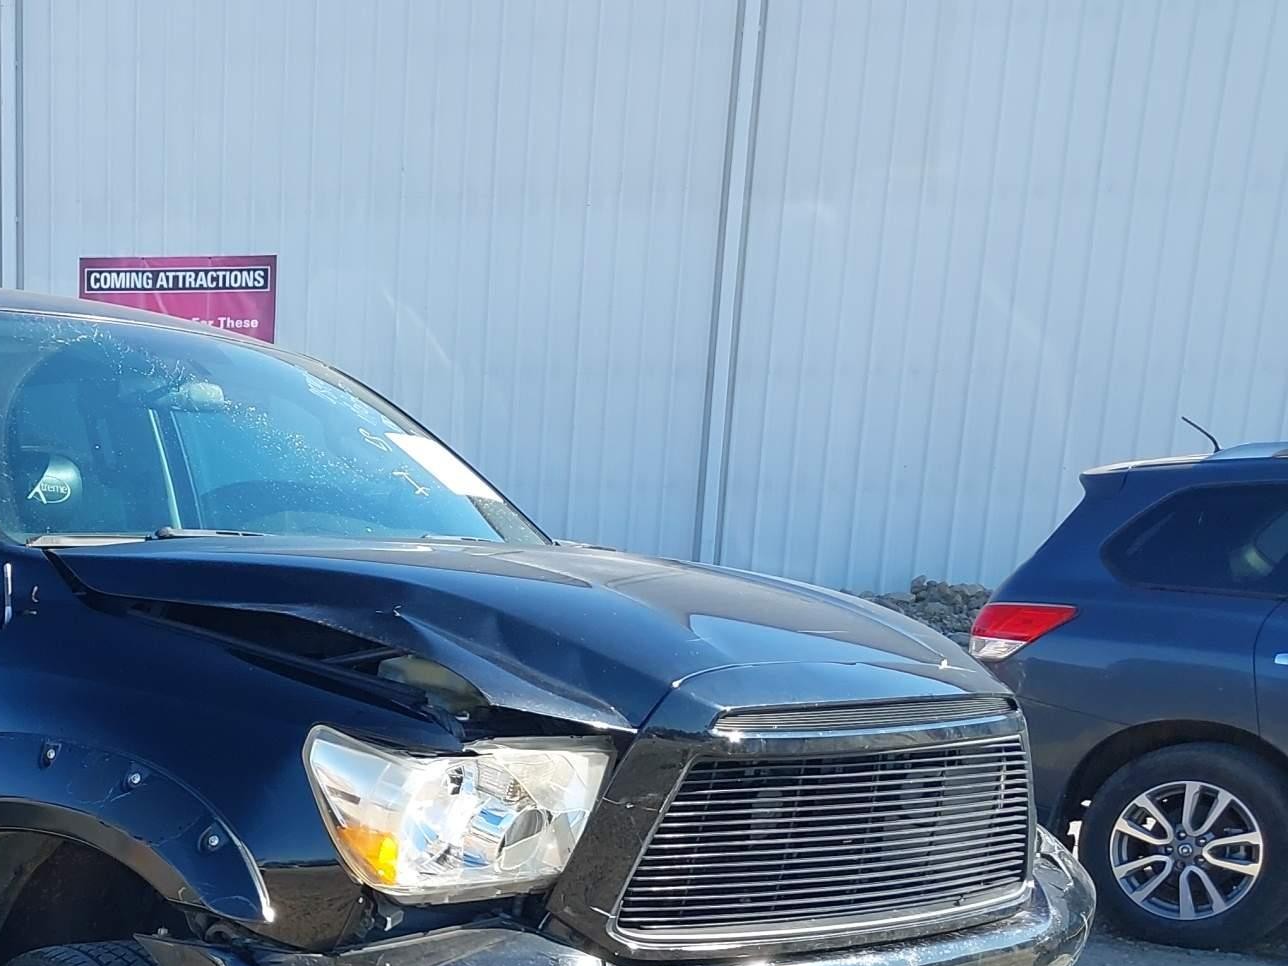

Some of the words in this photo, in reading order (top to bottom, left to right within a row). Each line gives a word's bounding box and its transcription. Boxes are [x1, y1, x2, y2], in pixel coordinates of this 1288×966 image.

[90, 271, 153, 289] COMING
[156, 270, 265, 289] ATTRACTIONS
[217, 317, 259, 329] These
